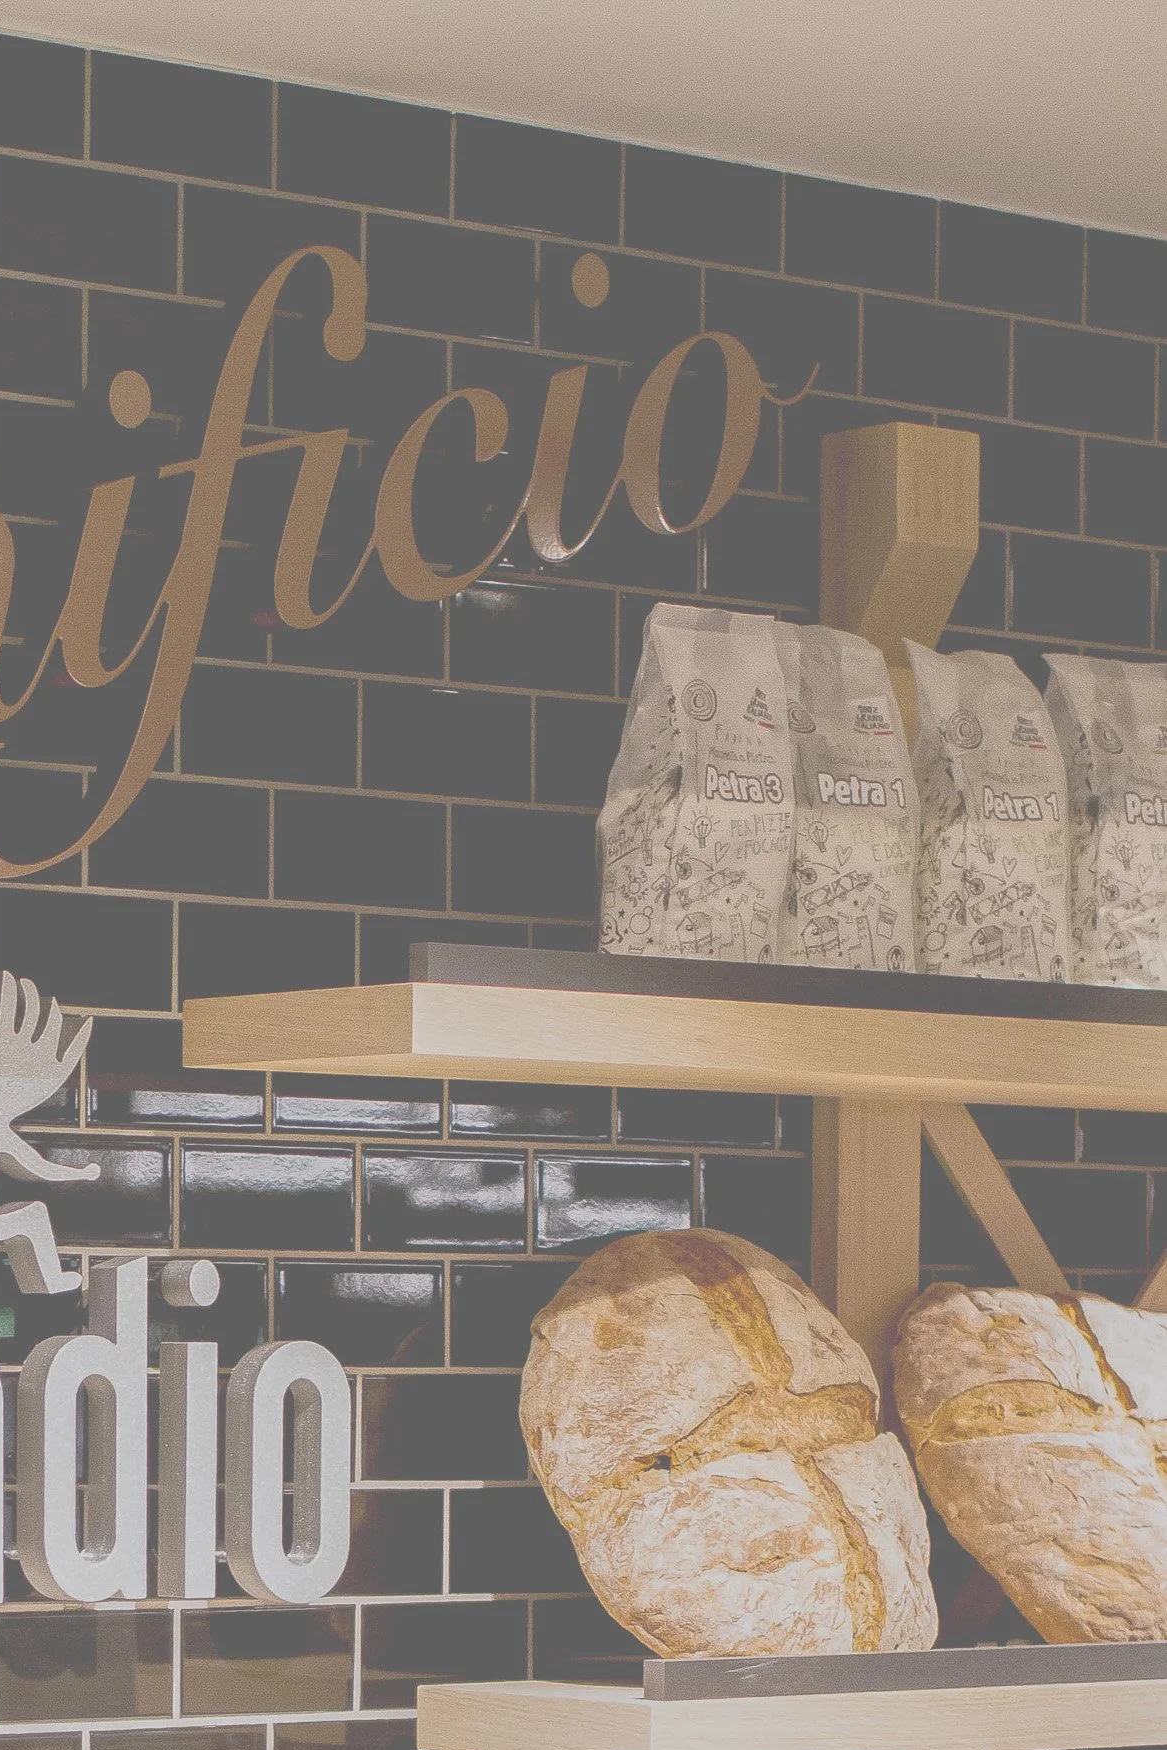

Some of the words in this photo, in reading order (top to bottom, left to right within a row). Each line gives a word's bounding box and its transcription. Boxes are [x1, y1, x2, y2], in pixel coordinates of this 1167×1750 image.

[705, 764, 764, 804] Petra
[764, 773, 784, 804] 3
[817, 771, 887, 807] Petra
[891, 778, 907, 808] 1
[983, 785, 1043, 821] Petra
[1044, 792, 1060, 821] 1
